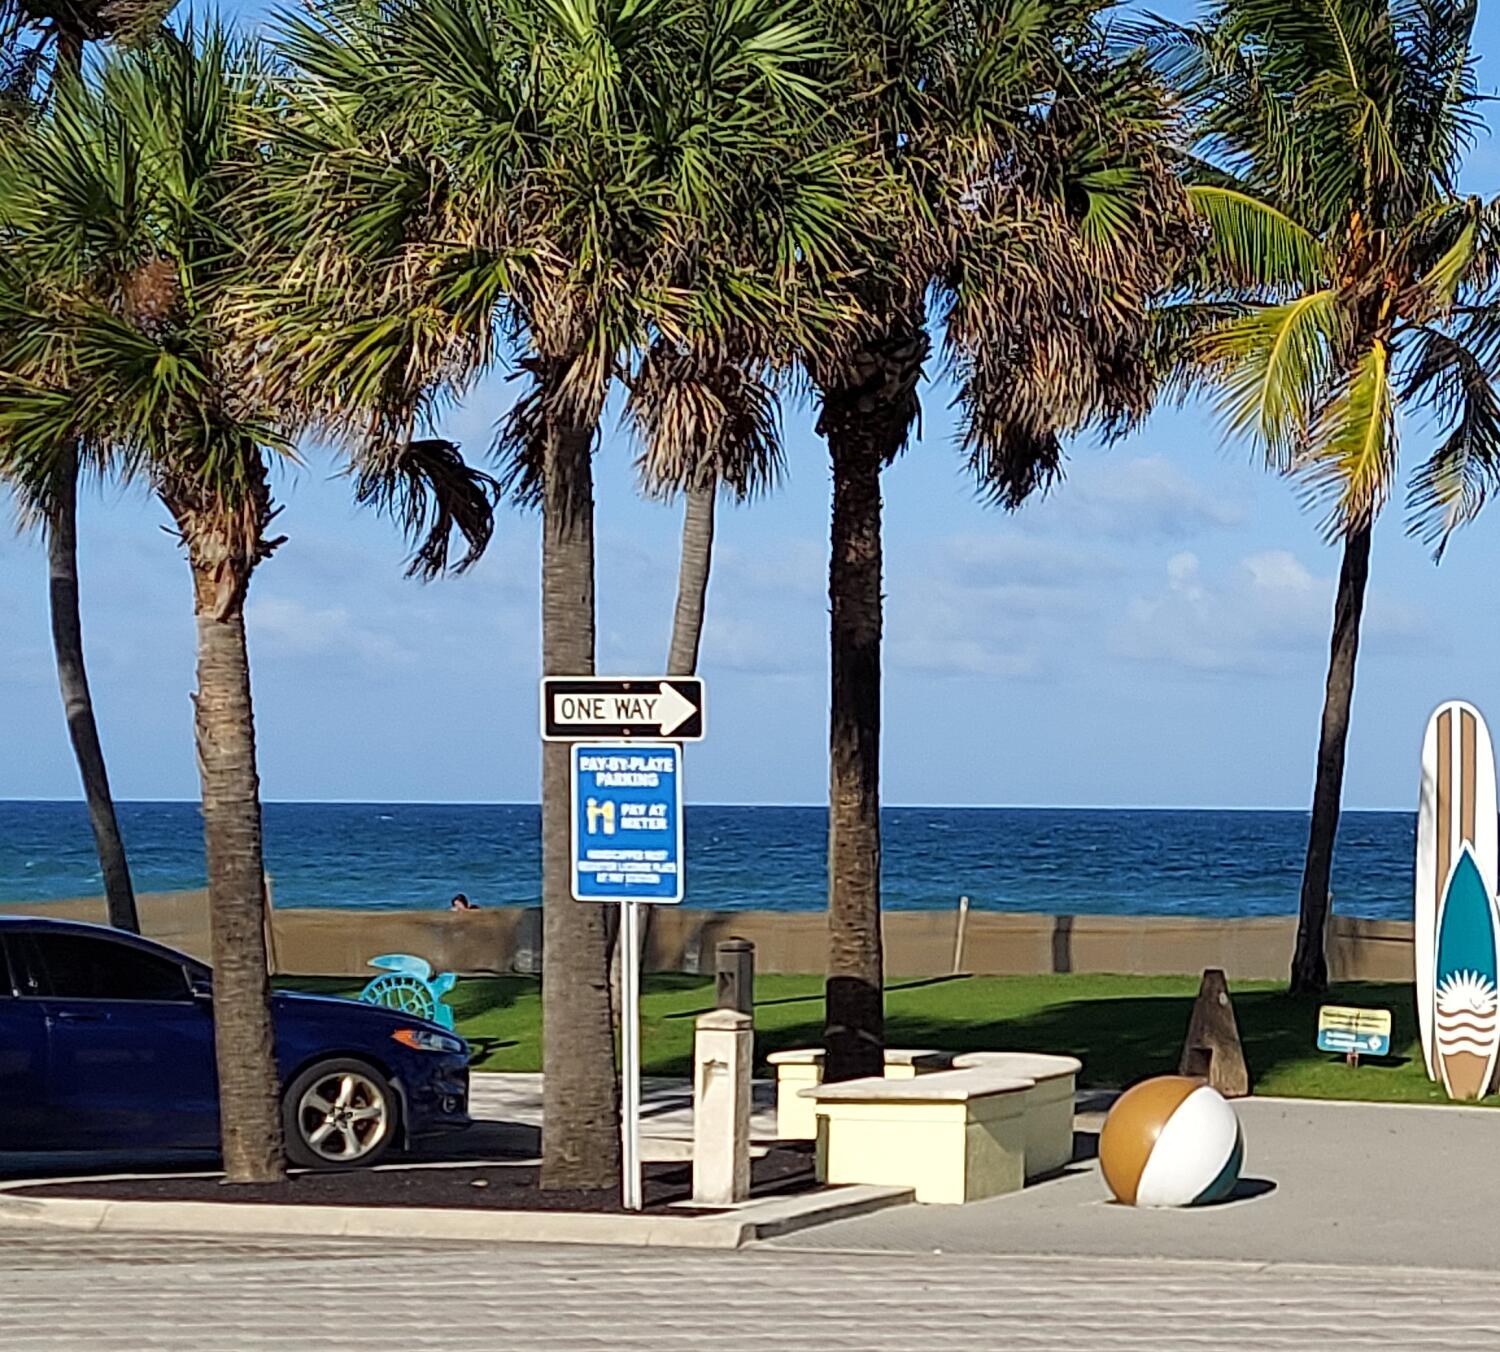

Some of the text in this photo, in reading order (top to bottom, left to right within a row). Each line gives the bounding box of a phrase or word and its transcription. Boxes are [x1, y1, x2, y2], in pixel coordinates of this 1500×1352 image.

[561, 698, 657, 720] ONE WAY
[580, 756, 674, 772] PAY-BY-PLATE
[597, 772, 659, 786] PARKING
[621, 804, 667, 816] PAY AT
[621, 817, 667, 829] METER
